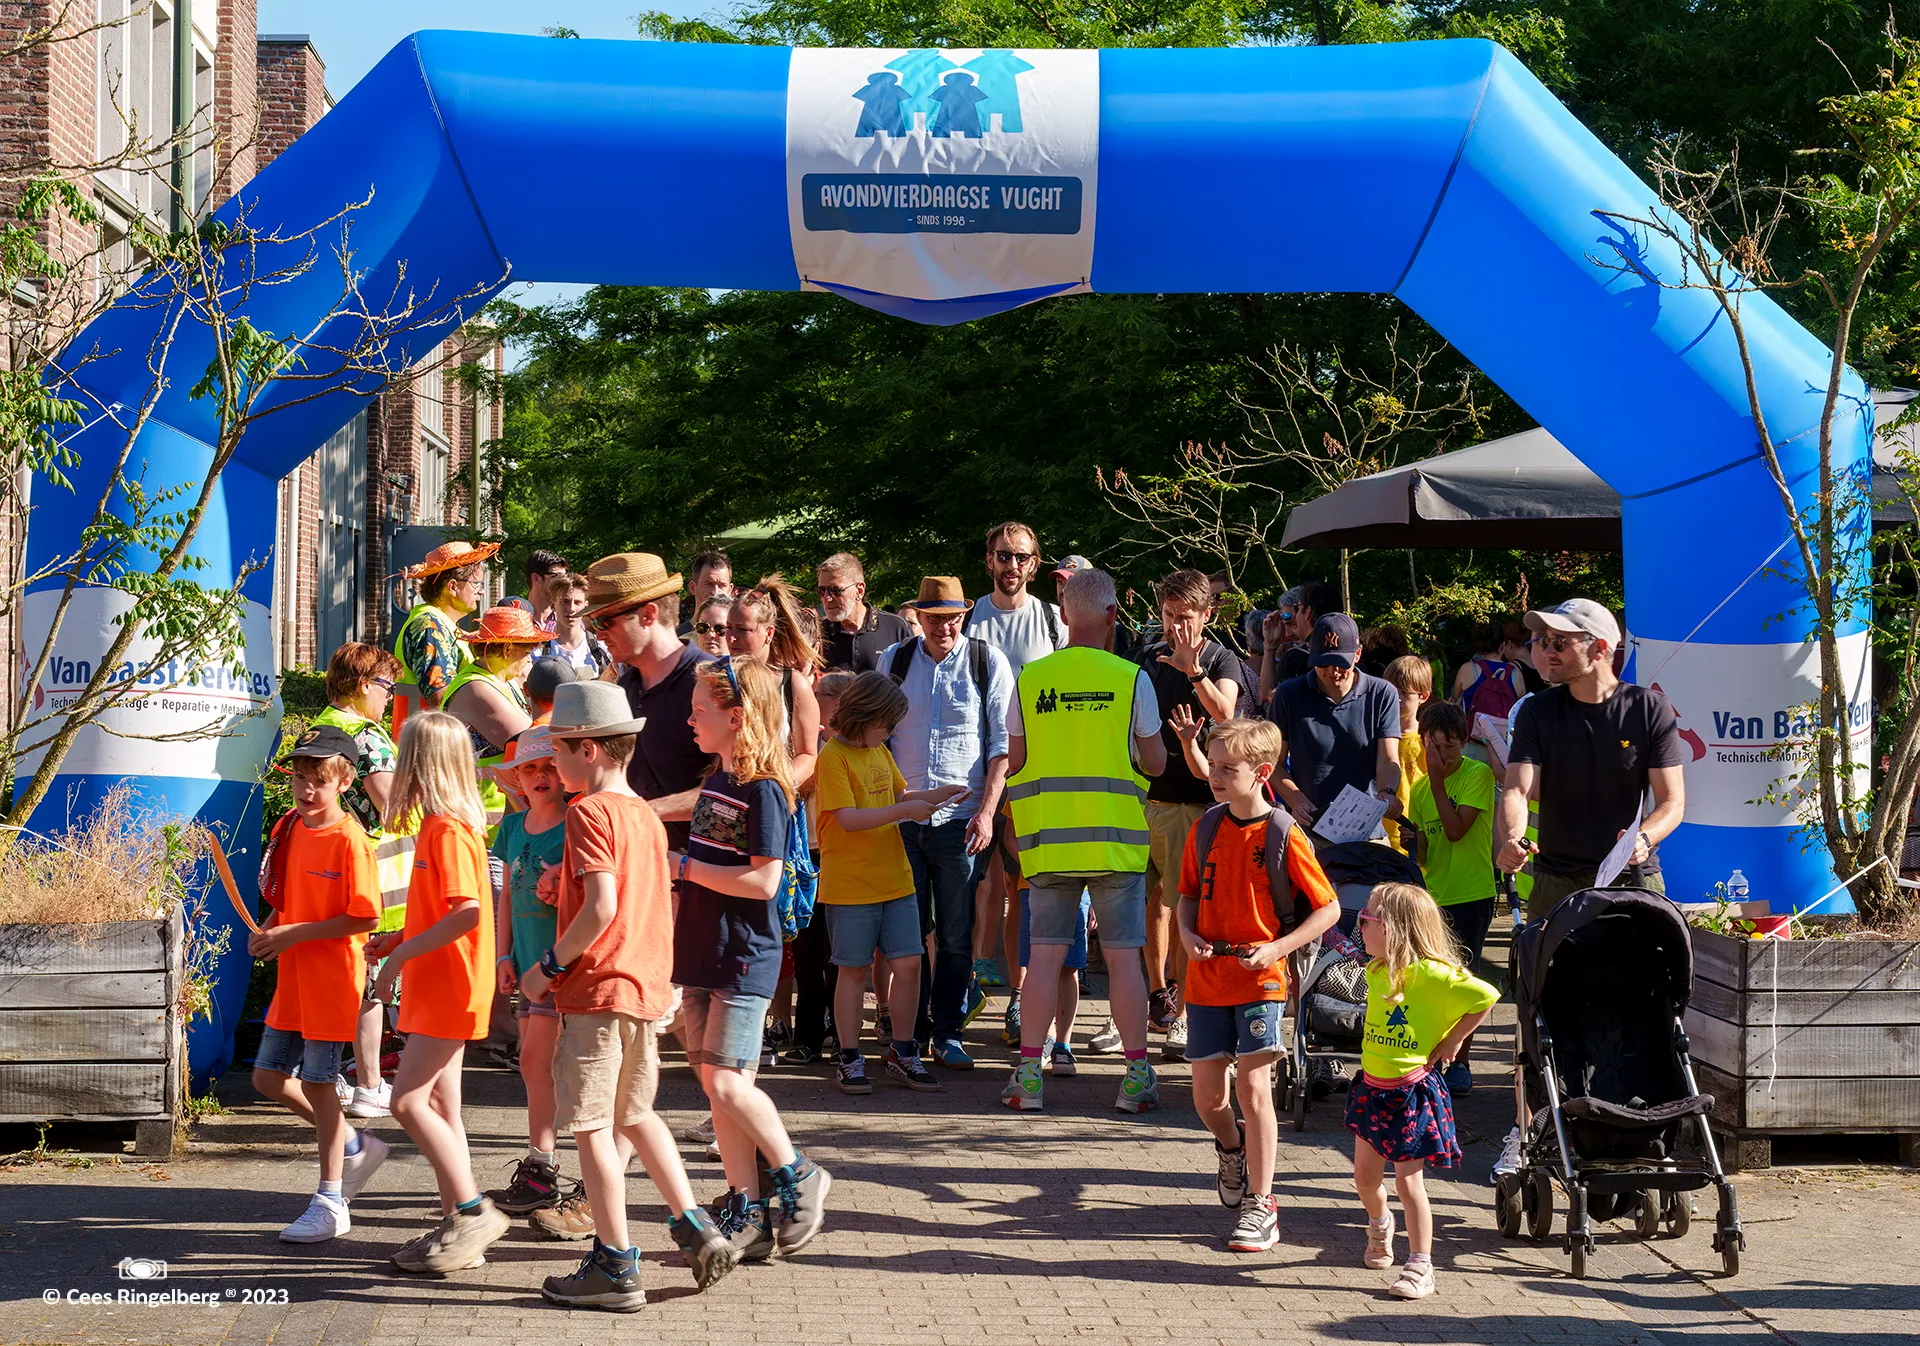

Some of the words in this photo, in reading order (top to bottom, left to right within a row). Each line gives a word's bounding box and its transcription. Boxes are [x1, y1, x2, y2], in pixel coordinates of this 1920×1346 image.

[820, 184, 990, 209] AVONDVIERDAAGSE
[1001, 186, 1063, 210] VUGHT
[916, 214, 940, 226] SINDS
[943, 215, 966, 227] 1998
[50, 656, 91, 684] Van
[161, 698, 211, 713] Reparatie
[1712, 710, 1764, 740] Van
[1716, 751, 1773, 764] Technische
